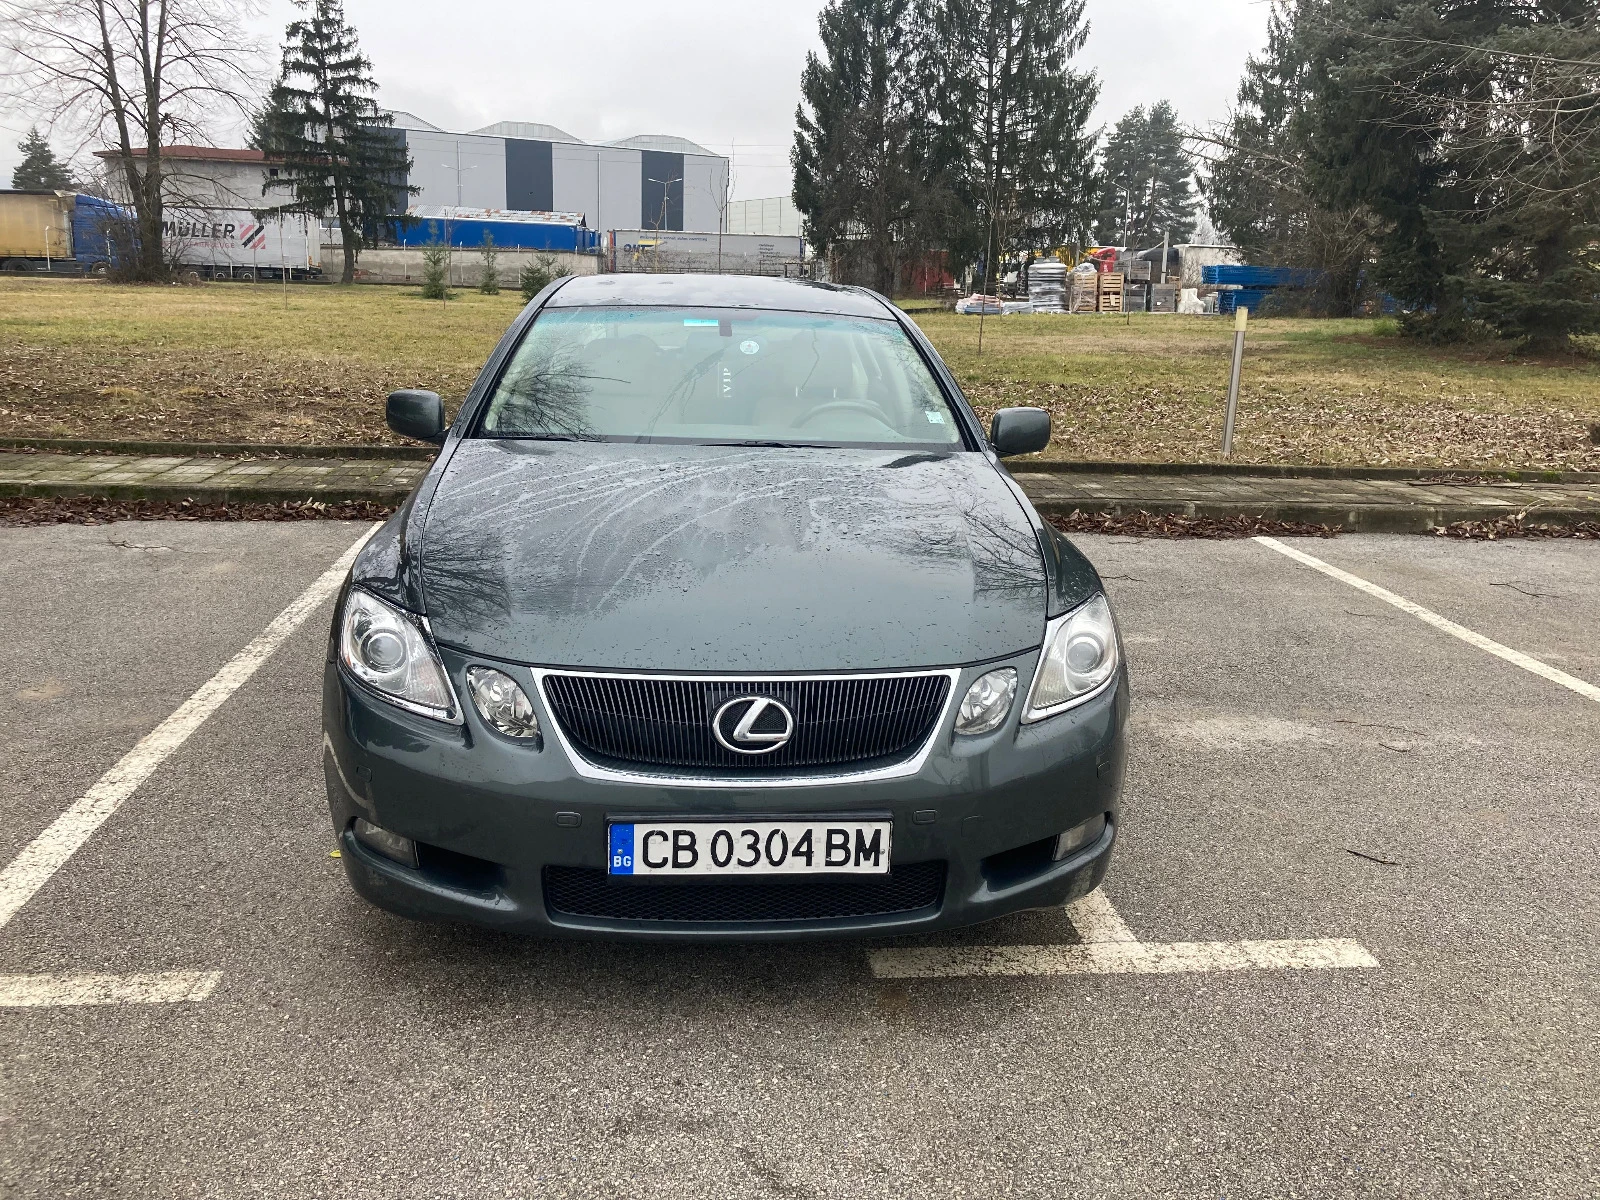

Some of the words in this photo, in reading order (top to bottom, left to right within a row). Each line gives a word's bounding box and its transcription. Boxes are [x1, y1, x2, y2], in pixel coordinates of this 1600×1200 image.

[162, 221, 236, 239] MÜLLER
[723, 368, 731, 393] VIP
[642, 829, 699, 869] CB
[710, 828, 814, 867] 0304
[825, 828, 882, 867] BM
[613, 855, 632, 867] BG
